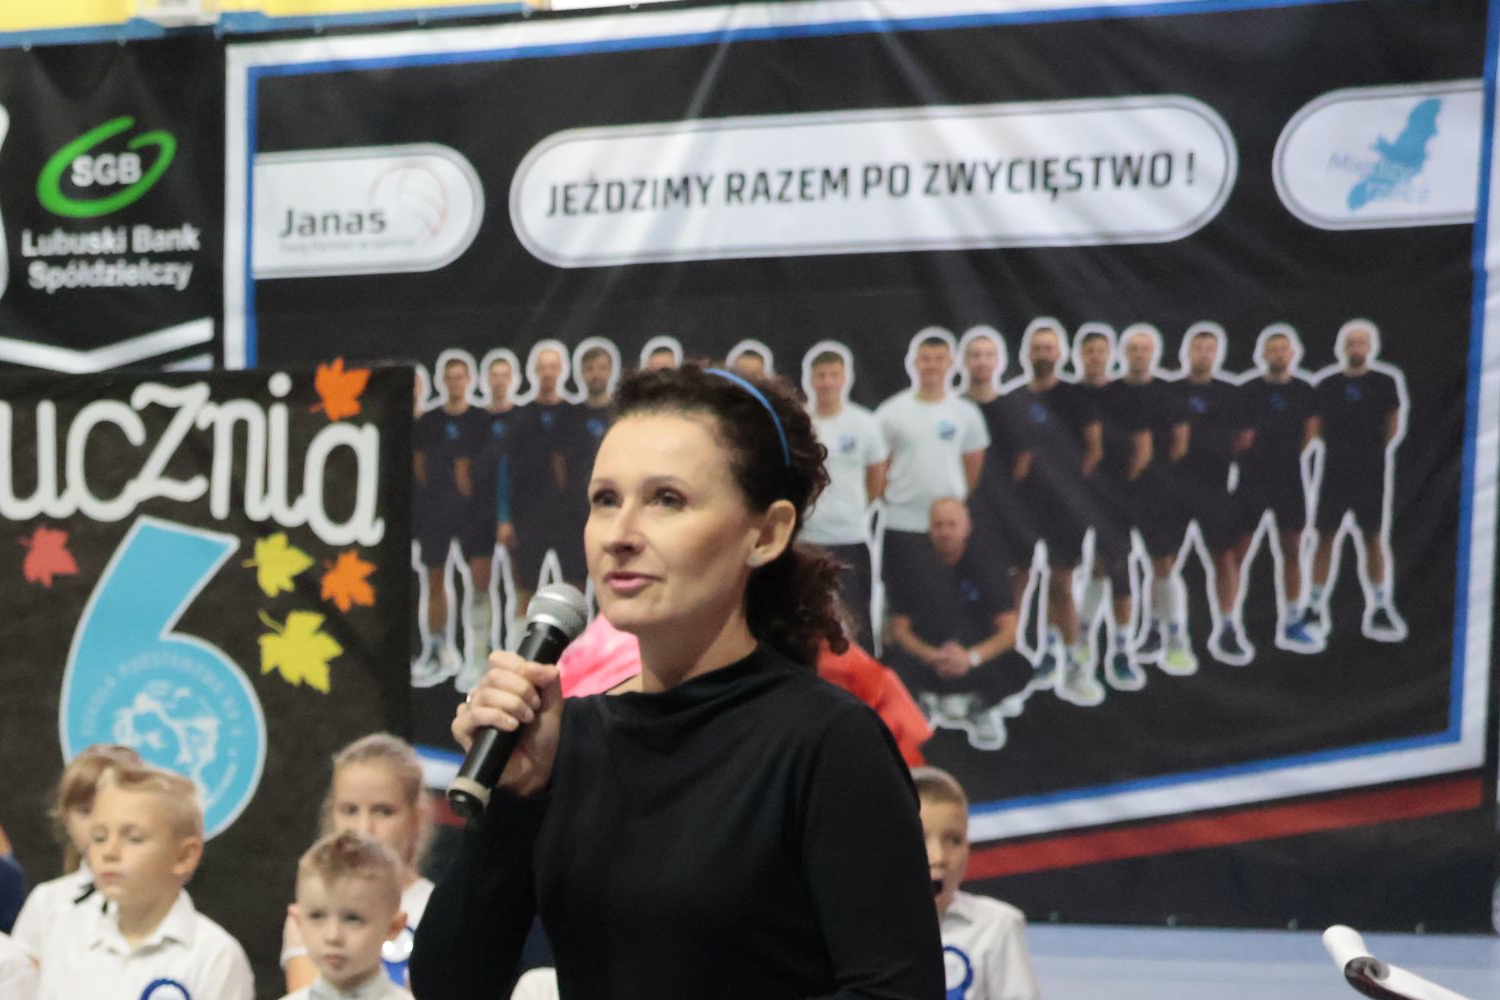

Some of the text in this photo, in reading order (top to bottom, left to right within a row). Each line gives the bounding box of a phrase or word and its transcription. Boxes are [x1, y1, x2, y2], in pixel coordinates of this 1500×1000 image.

[71, 152, 142, 187] SGB
[724, 166, 849, 205] RAZEM
[862, 164, 911, 198] PO
[924, 152, 1173, 202] ZWYCIĘSTWO
[21, 222, 201, 257] Lubuski Bank
[278, 208, 387, 239] Janas
[28, 257, 193, 295] Spółdzielczy
